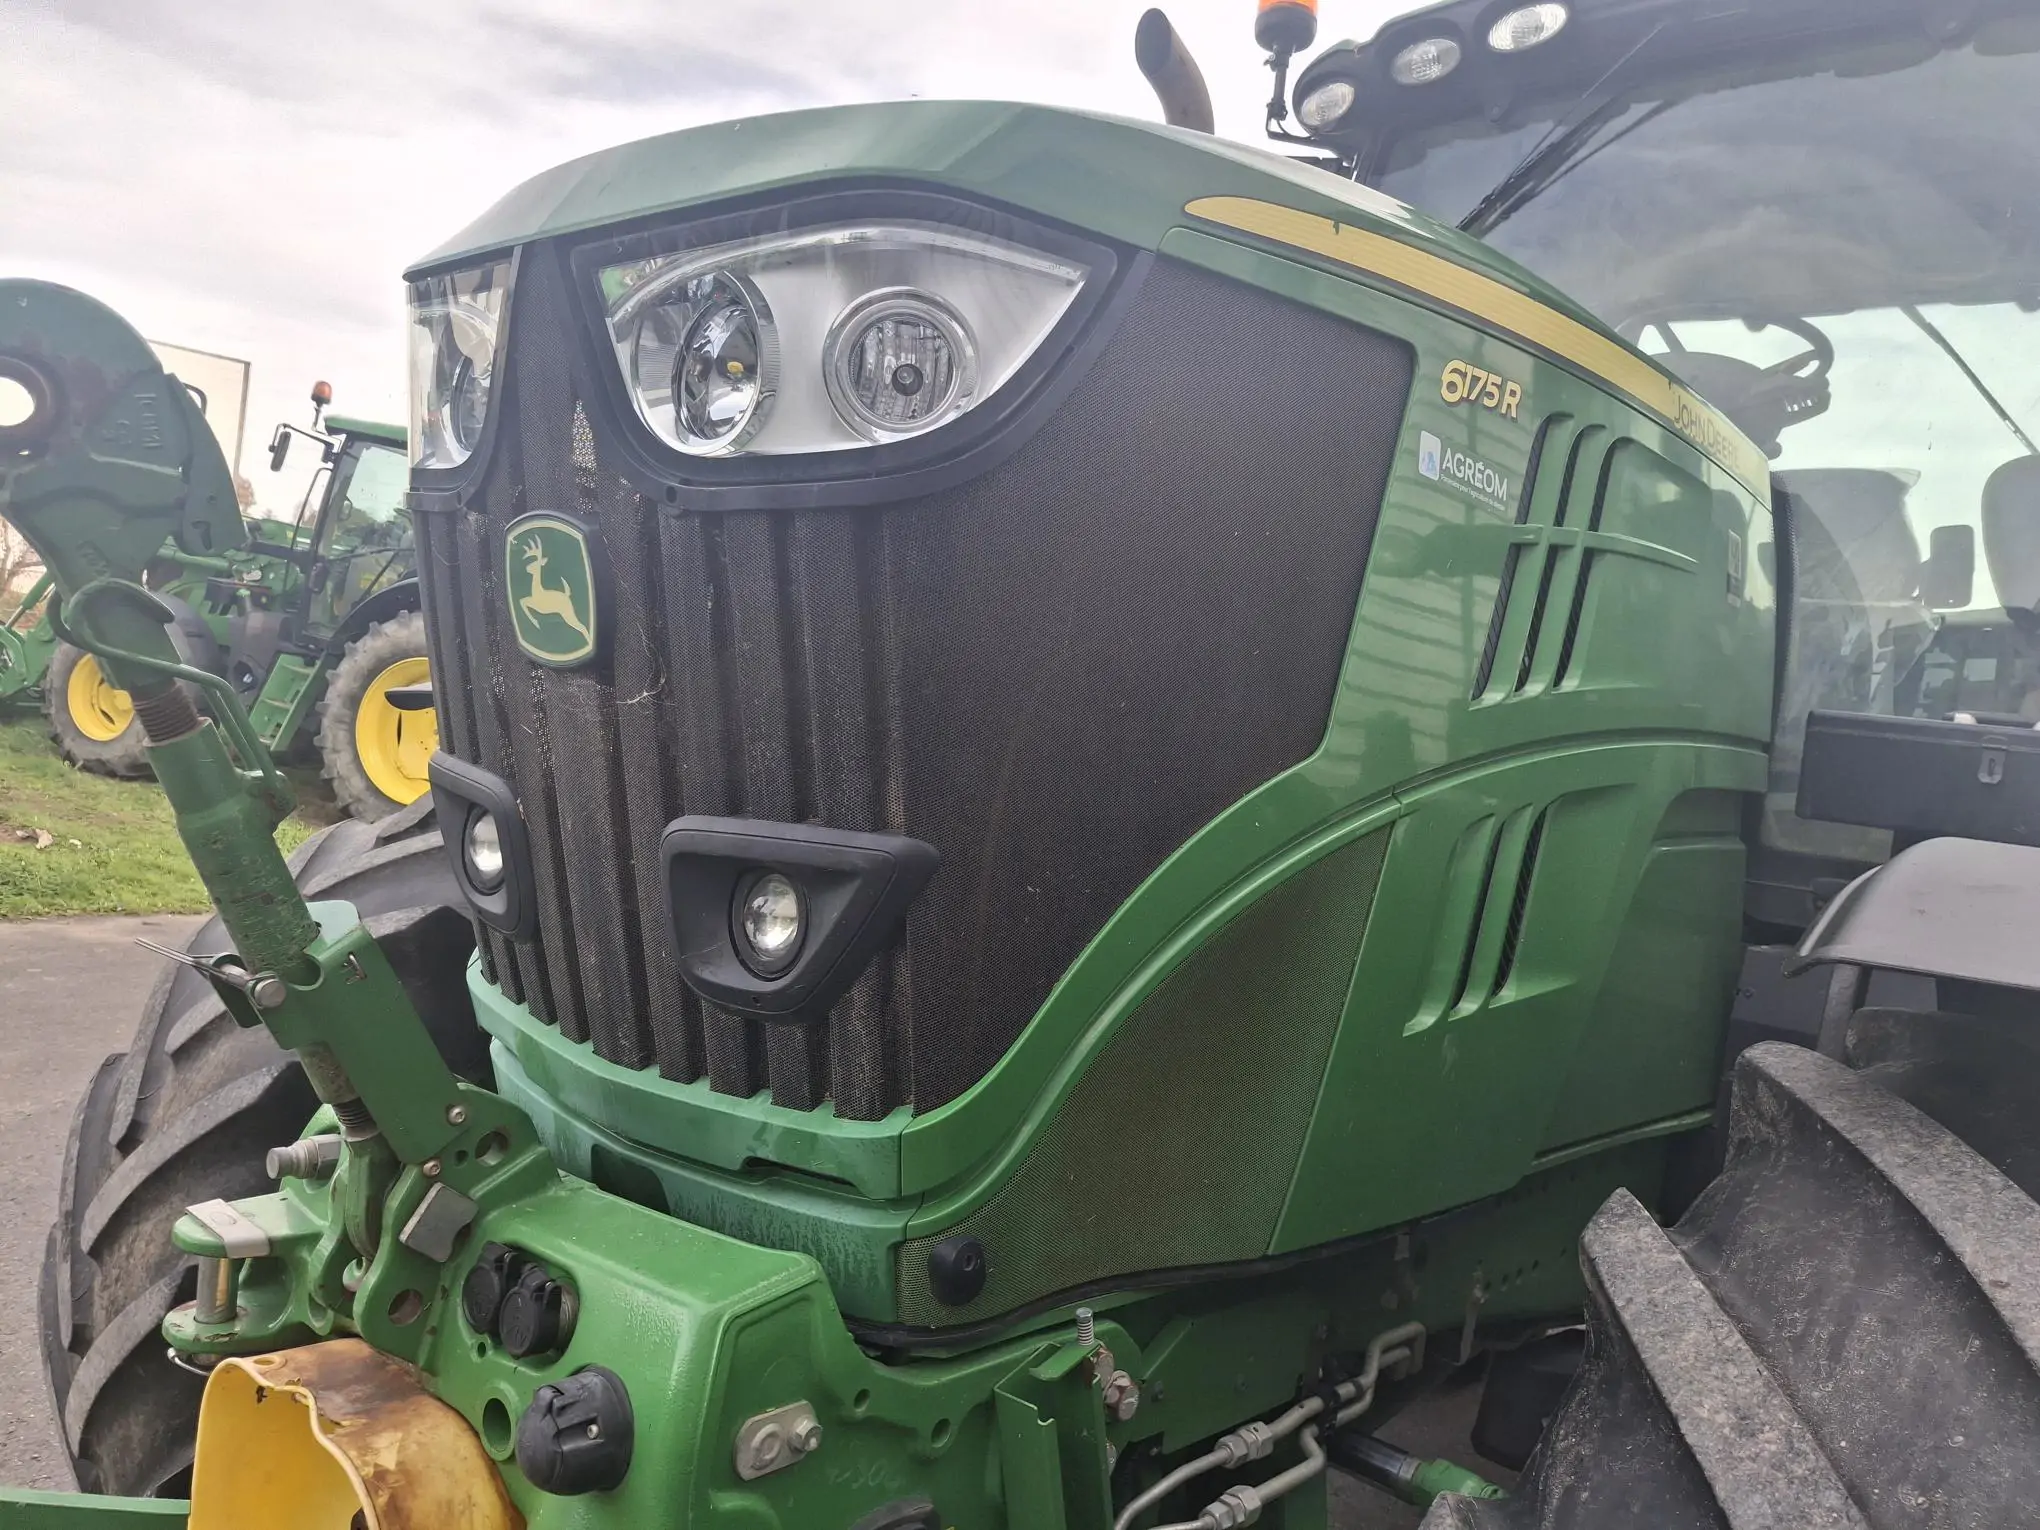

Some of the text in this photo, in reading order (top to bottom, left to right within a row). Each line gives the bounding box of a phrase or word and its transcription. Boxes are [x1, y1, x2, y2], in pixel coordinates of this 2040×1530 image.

[1440, 359, 1522, 419] 6175R
[1674, 395, 1706, 445] JOHN
[1442, 447, 1508, 501] AGRÉOM
